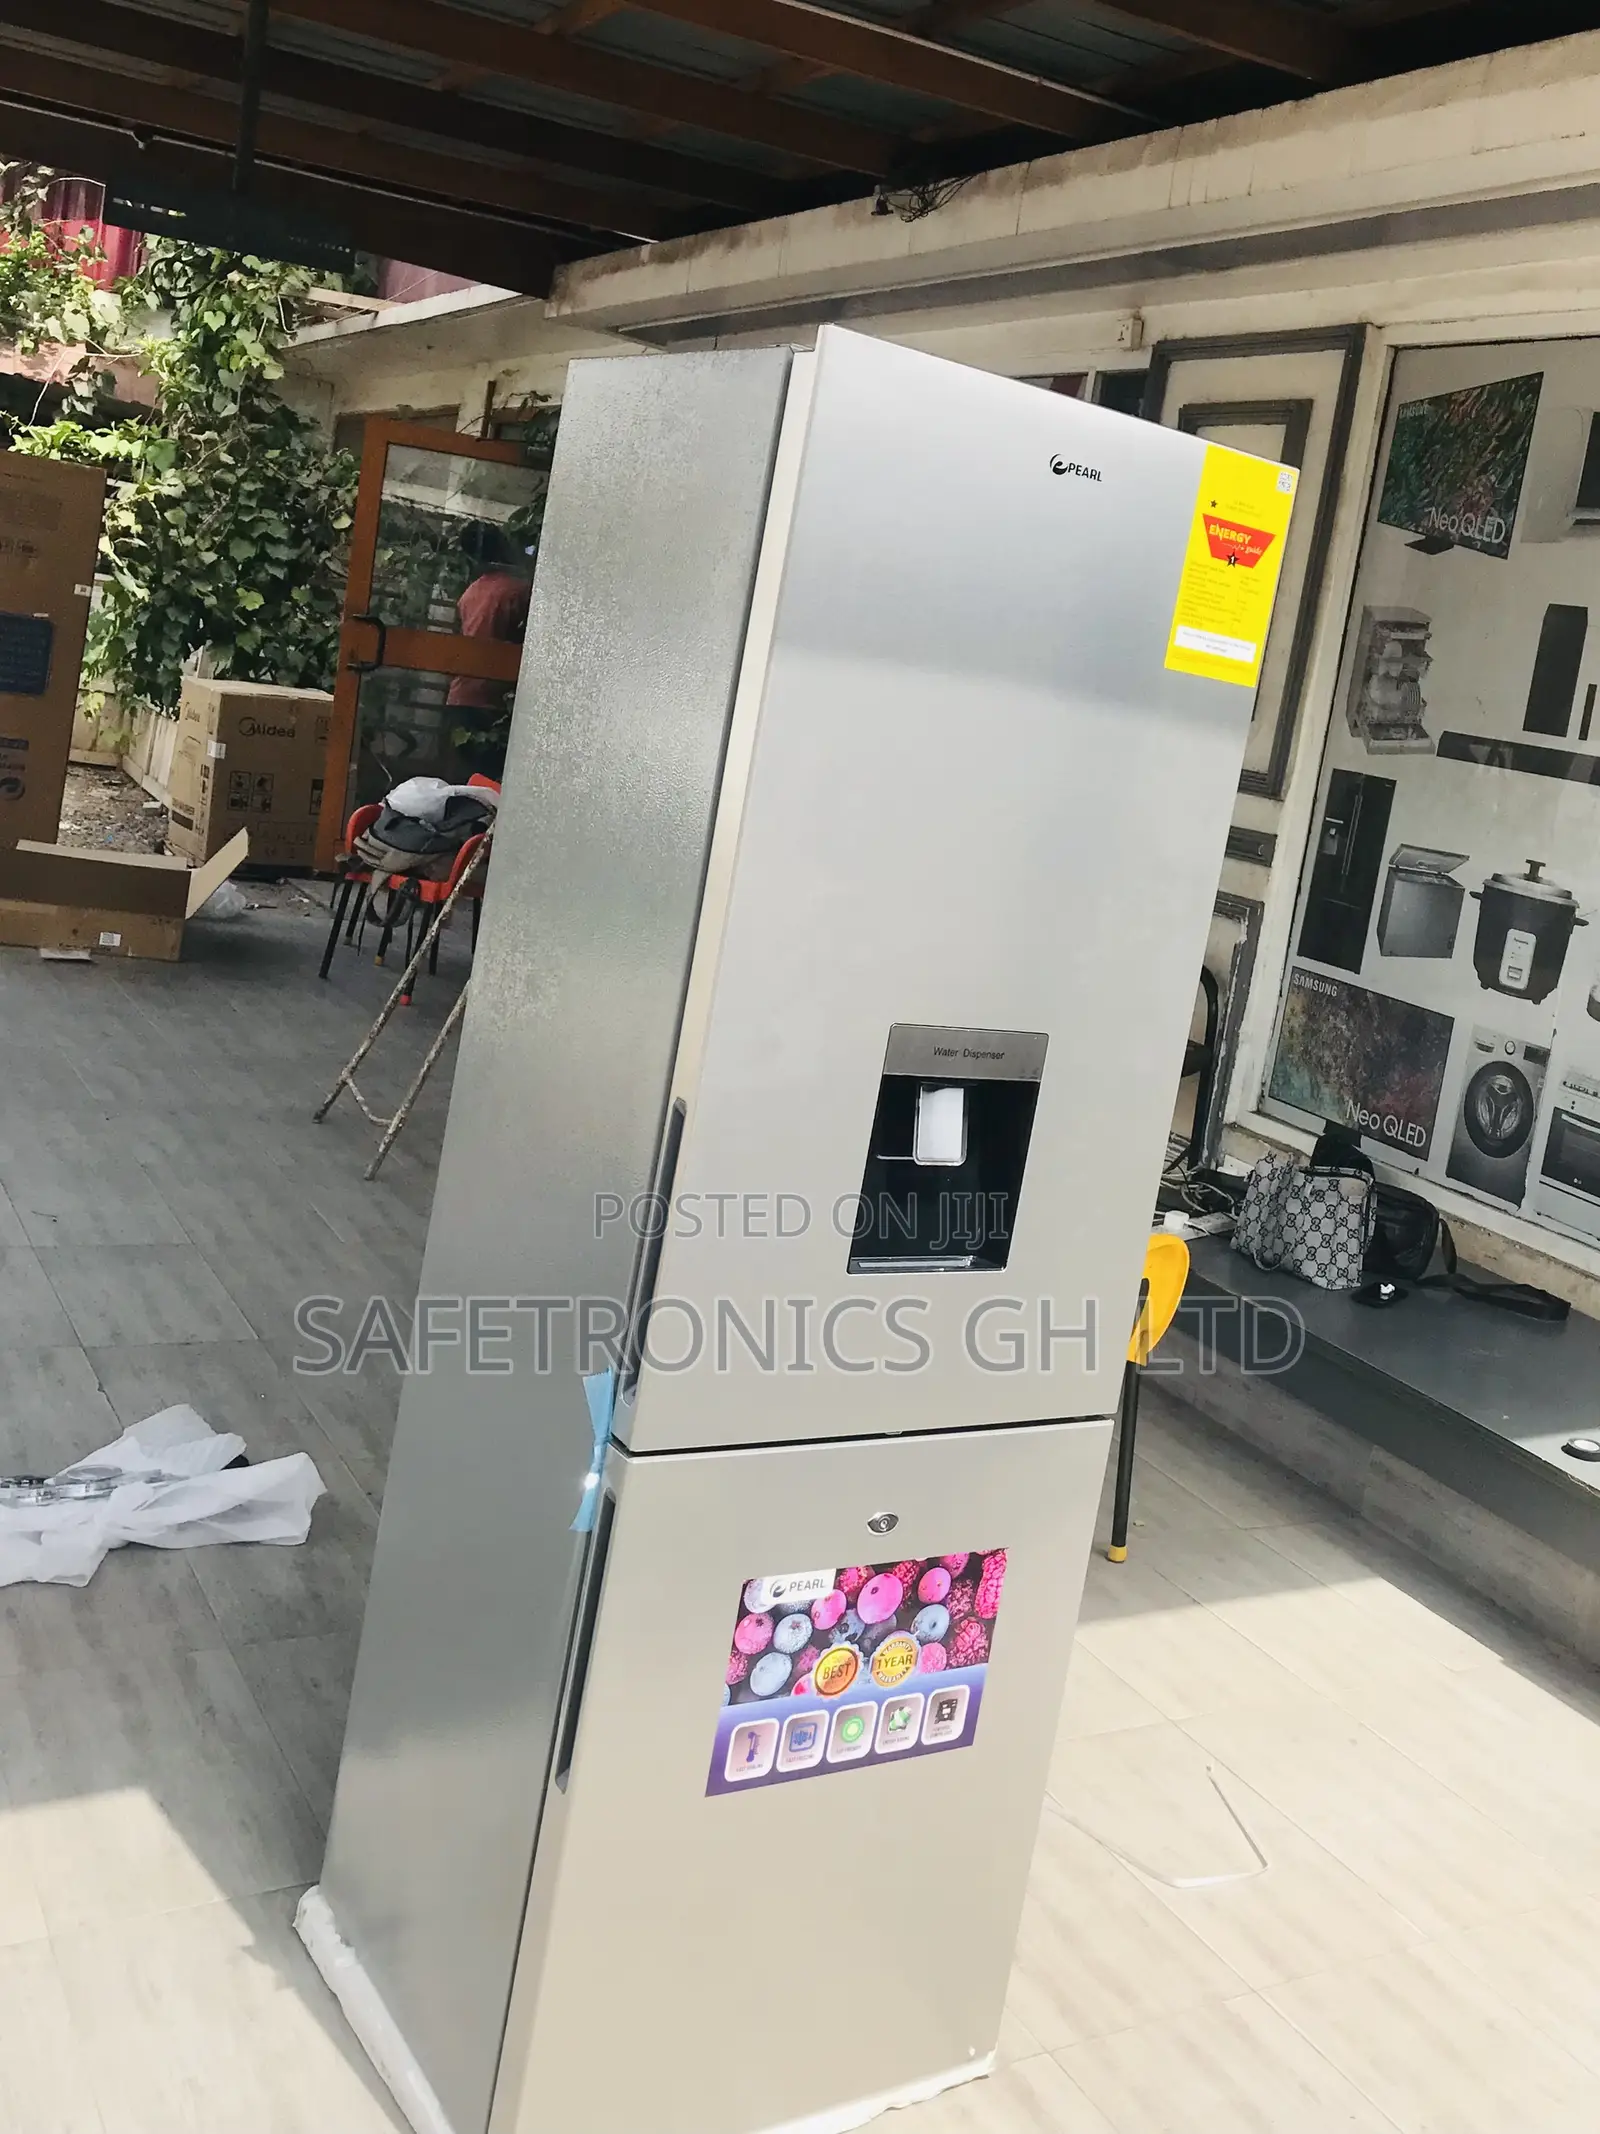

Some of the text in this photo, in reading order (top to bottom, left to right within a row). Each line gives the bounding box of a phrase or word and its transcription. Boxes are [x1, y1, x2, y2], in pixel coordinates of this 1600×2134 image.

[1067, 462, 1103, 482] PEARL
[1208, 523, 1252, 546] ENERGY
[1427, 506, 1506, 544] Neo QLED
[238, 716, 296, 739] Midea
[1293, 973, 1338, 997] SAMSUNG
[933, 1046, 1005, 1060] Water Dispenser
[1346, 1097, 1427, 1148] Neo QLED
[789, 1578, 826, 1593] PEARL
[822, 1662, 852, 1680] BEST
[884, 1654, 913, 1669] YEAR
